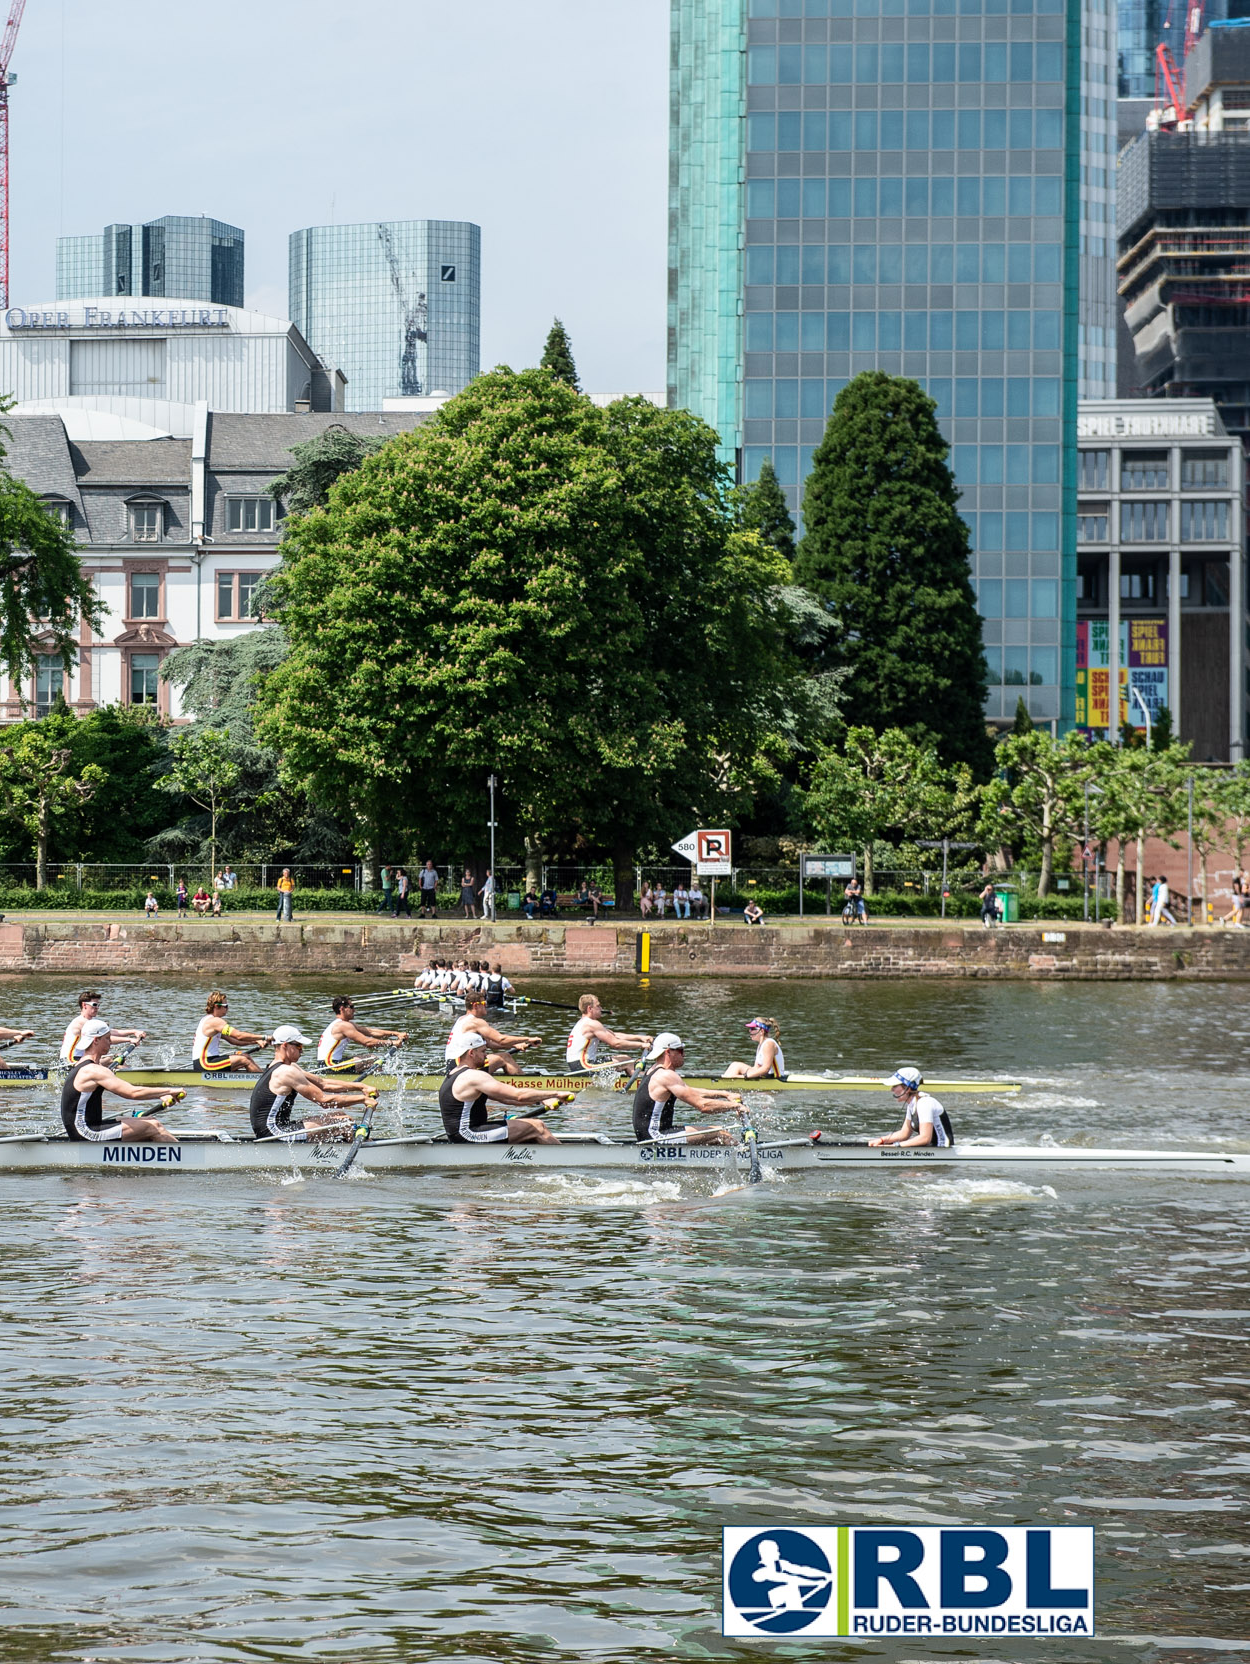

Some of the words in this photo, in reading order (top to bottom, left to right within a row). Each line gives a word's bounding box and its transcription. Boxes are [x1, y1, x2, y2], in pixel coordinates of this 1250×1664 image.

[6, 308, 69, 328] OPER
[84, 307, 228, 327] FRANKFURT
[1131, 671, 1164, 683] SCHAU
[103, 1146, 181, 1162] MINDEN
[656, 1147, 686, 1158] RBL
